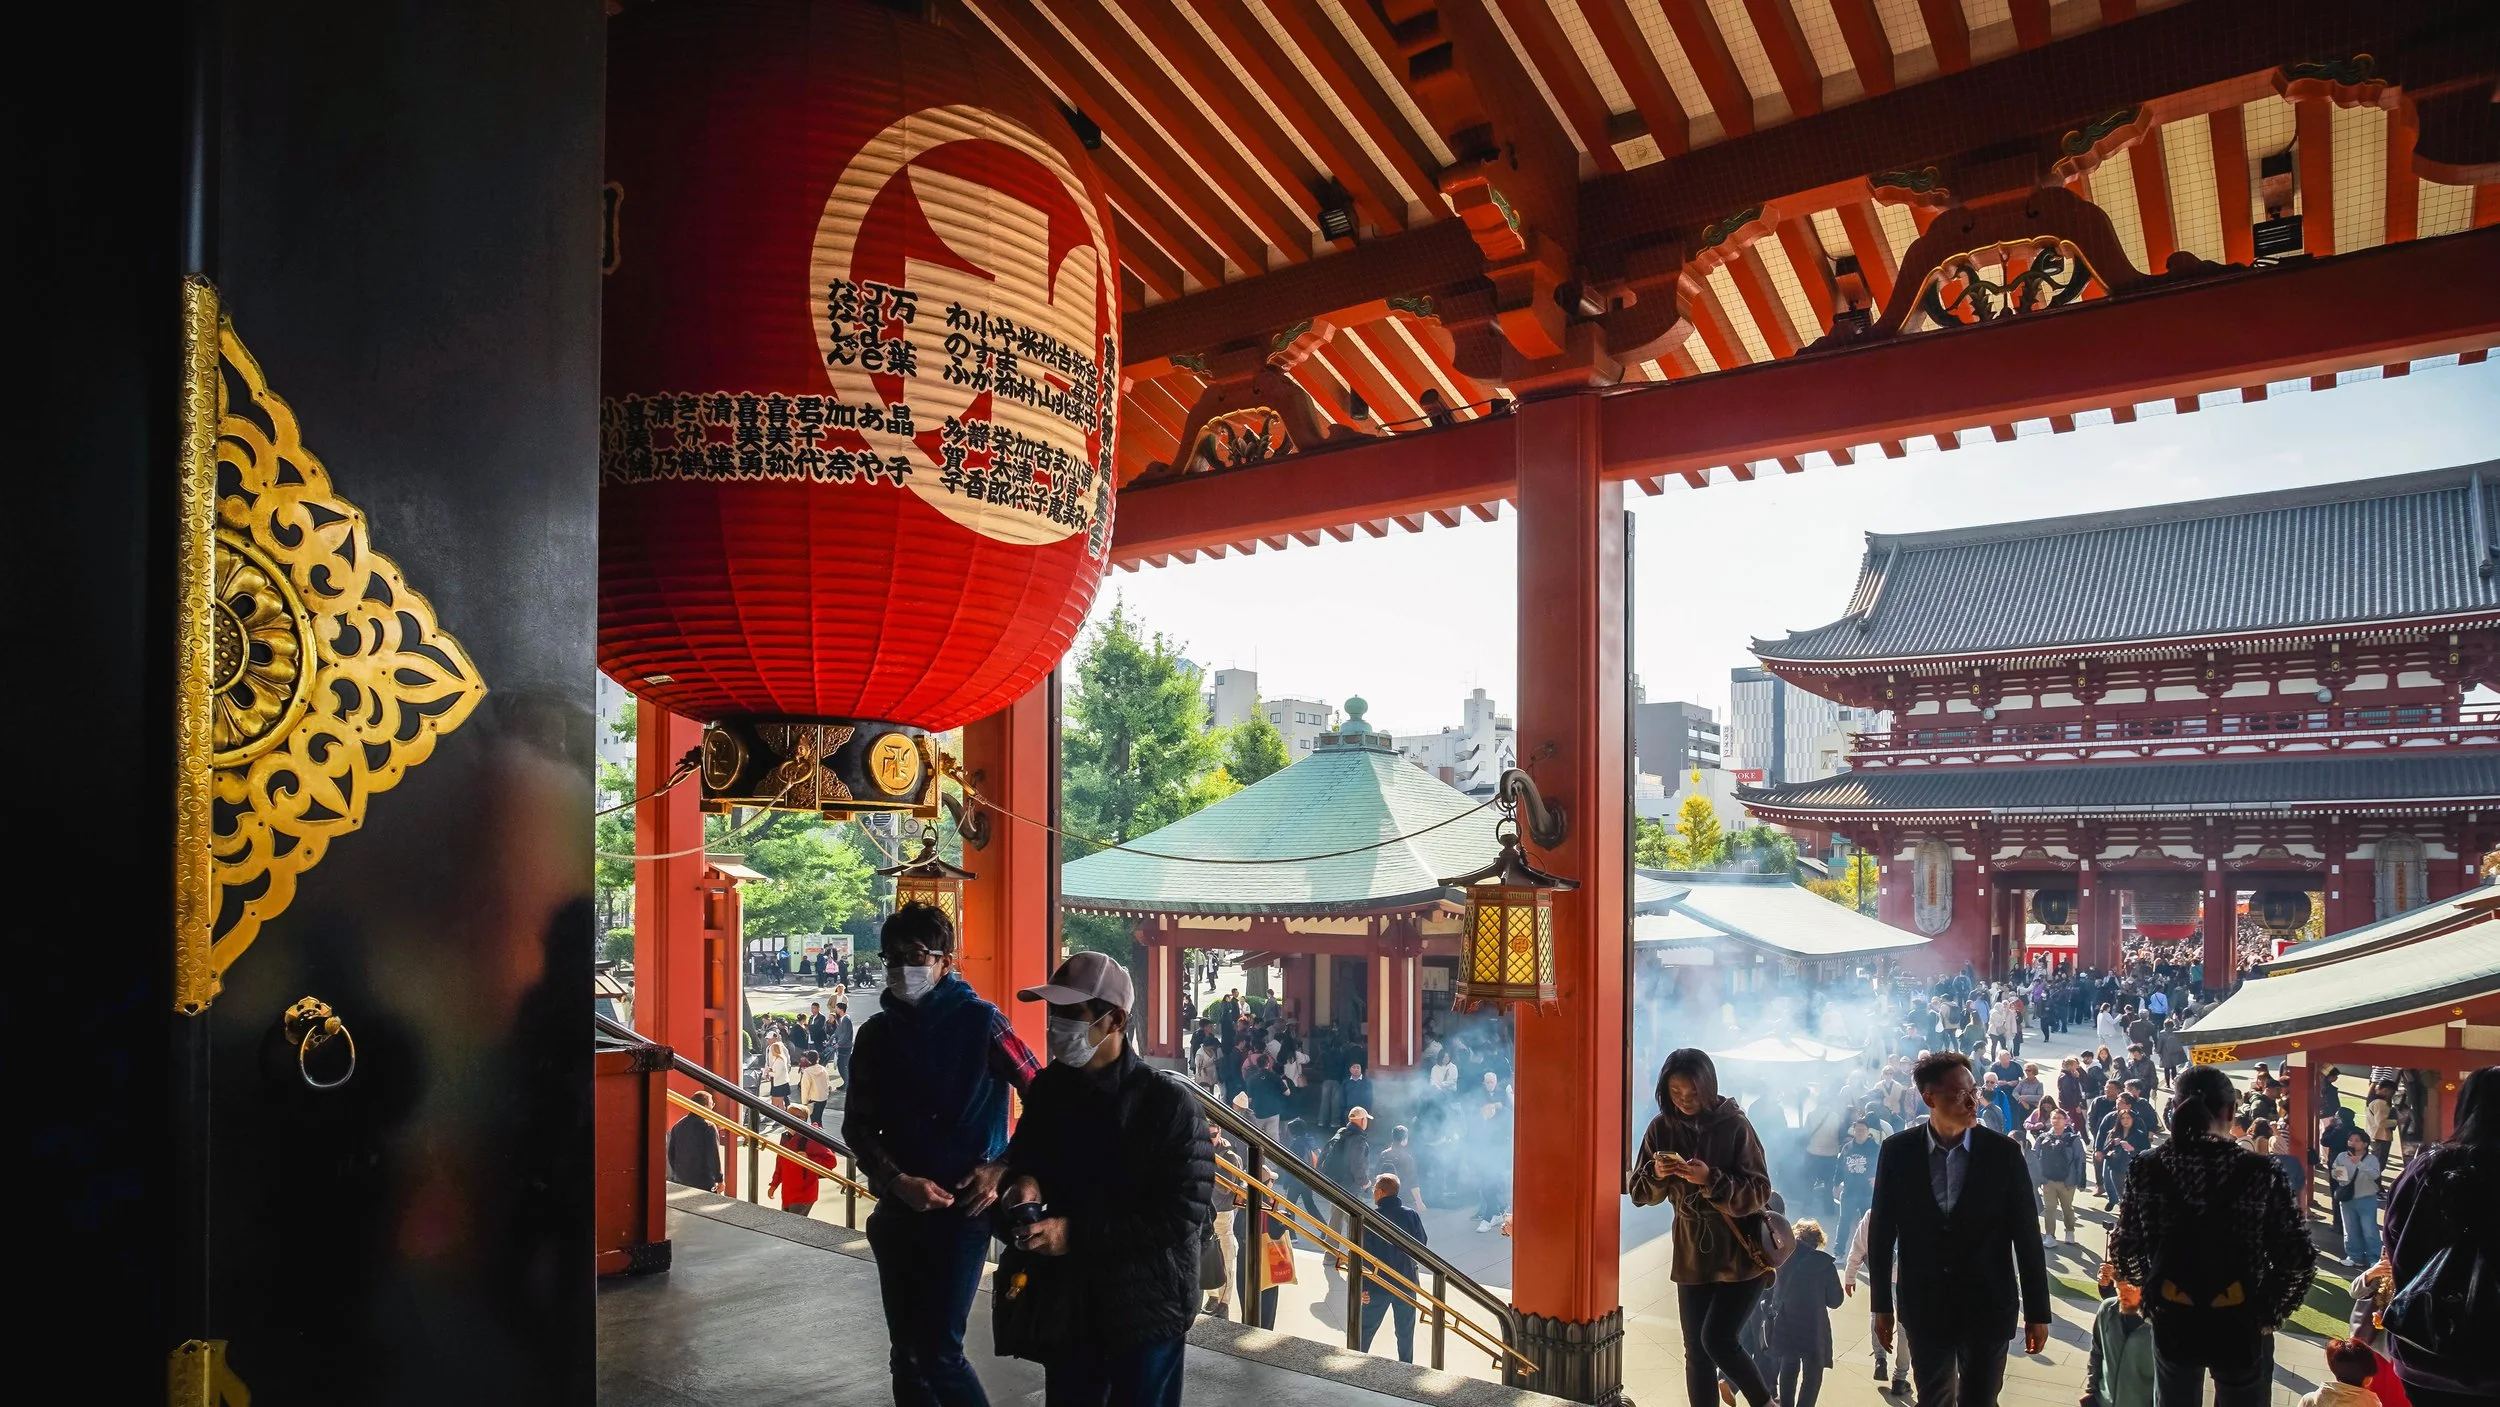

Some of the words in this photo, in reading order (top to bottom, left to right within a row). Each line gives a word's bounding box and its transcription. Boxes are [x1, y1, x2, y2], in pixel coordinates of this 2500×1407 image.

[860, 282, 888, 370] Jade
[887, 288, 918, 377] 万葉
[971, 311, 996, 391] 小すが
[1017, 326, 1038, 406] 米村
[1037, 333, 1057, 414] 松山
[1055, 343, 1072, 420] 吉兆
[1085, 359, 1098, 433] 金田中
[702, 394, 736, 478] 清葉
[735, 393, 764, 476] 喜美勇
[794, 397, 825, 479] 君千代
[824, 398, 857, 480] 加奈
[856, 403, 884, 481] あや
[885, 404, 914, 485] 晶子
[939, 415, 967, 494] 多賀子
[963, 421, 990, 500] 静香
[987, 425, 1015, 506] 栄太郎
[1009, 432, 1035, 511] 加津代
